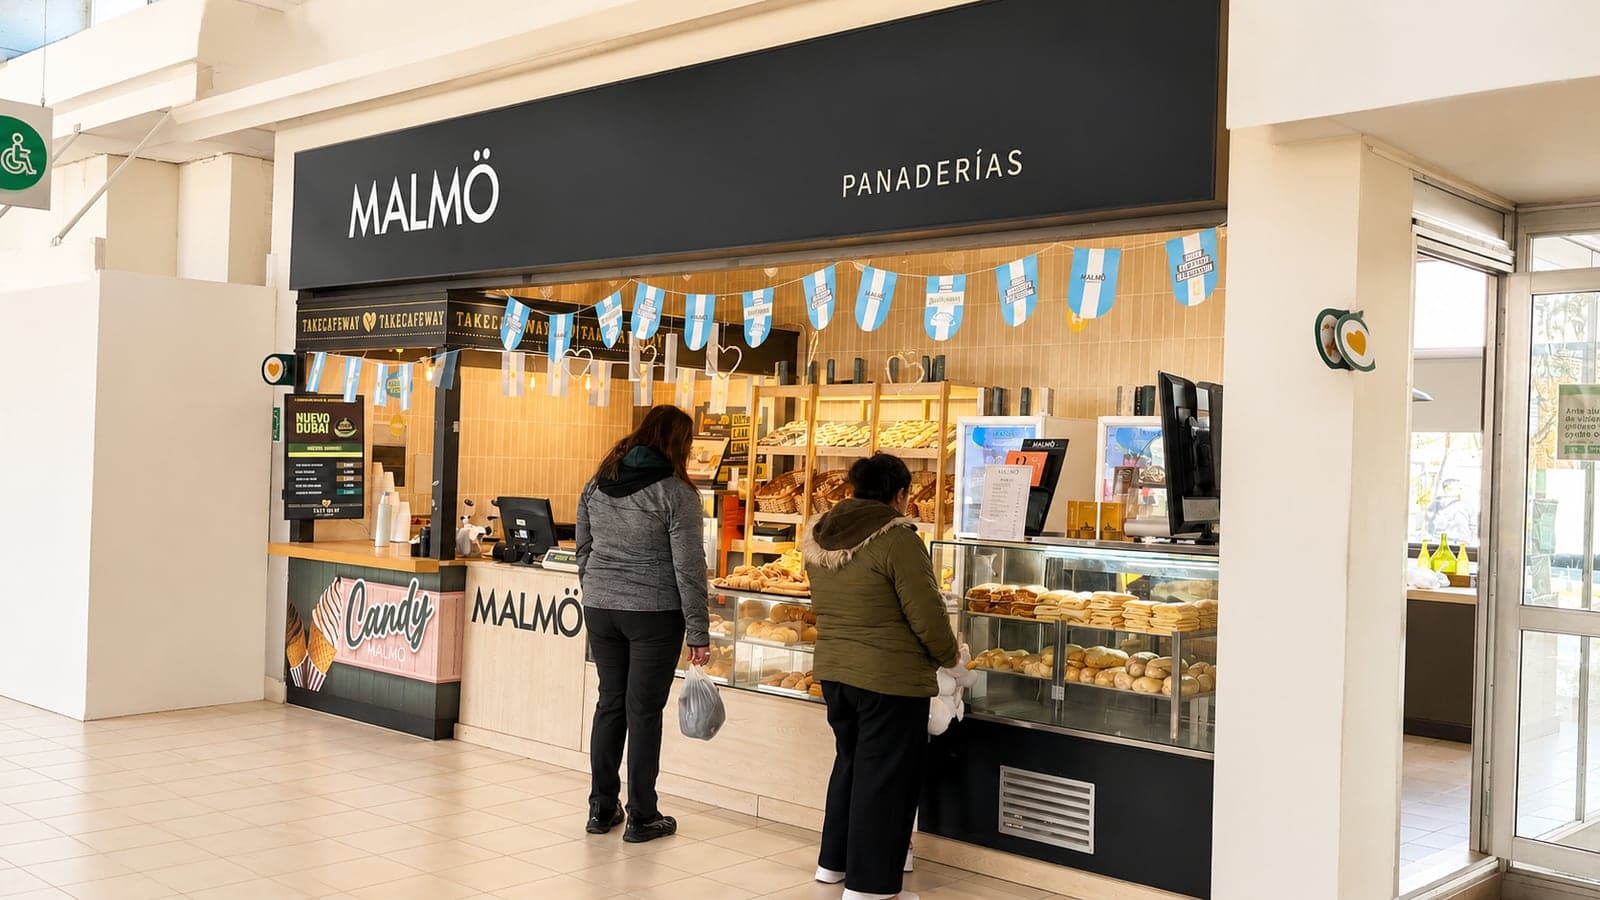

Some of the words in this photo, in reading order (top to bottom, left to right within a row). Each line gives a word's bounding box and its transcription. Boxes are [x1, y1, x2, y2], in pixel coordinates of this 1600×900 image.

[348, 148, 500, 239] MALMÖ
[842, 149, 1023, 198] PANADERÍAS
[303, 315, 359, 332] TAKECAFEWAY
[380, 311, 444, 331] TAKECAFEWAY
[296, 412, 330, 424] NUEVO
[296, 423, 329, 434] DUBAI
[347, 579, 434, 652] Candy
[471, 587, 584, 638] MALMÖ
